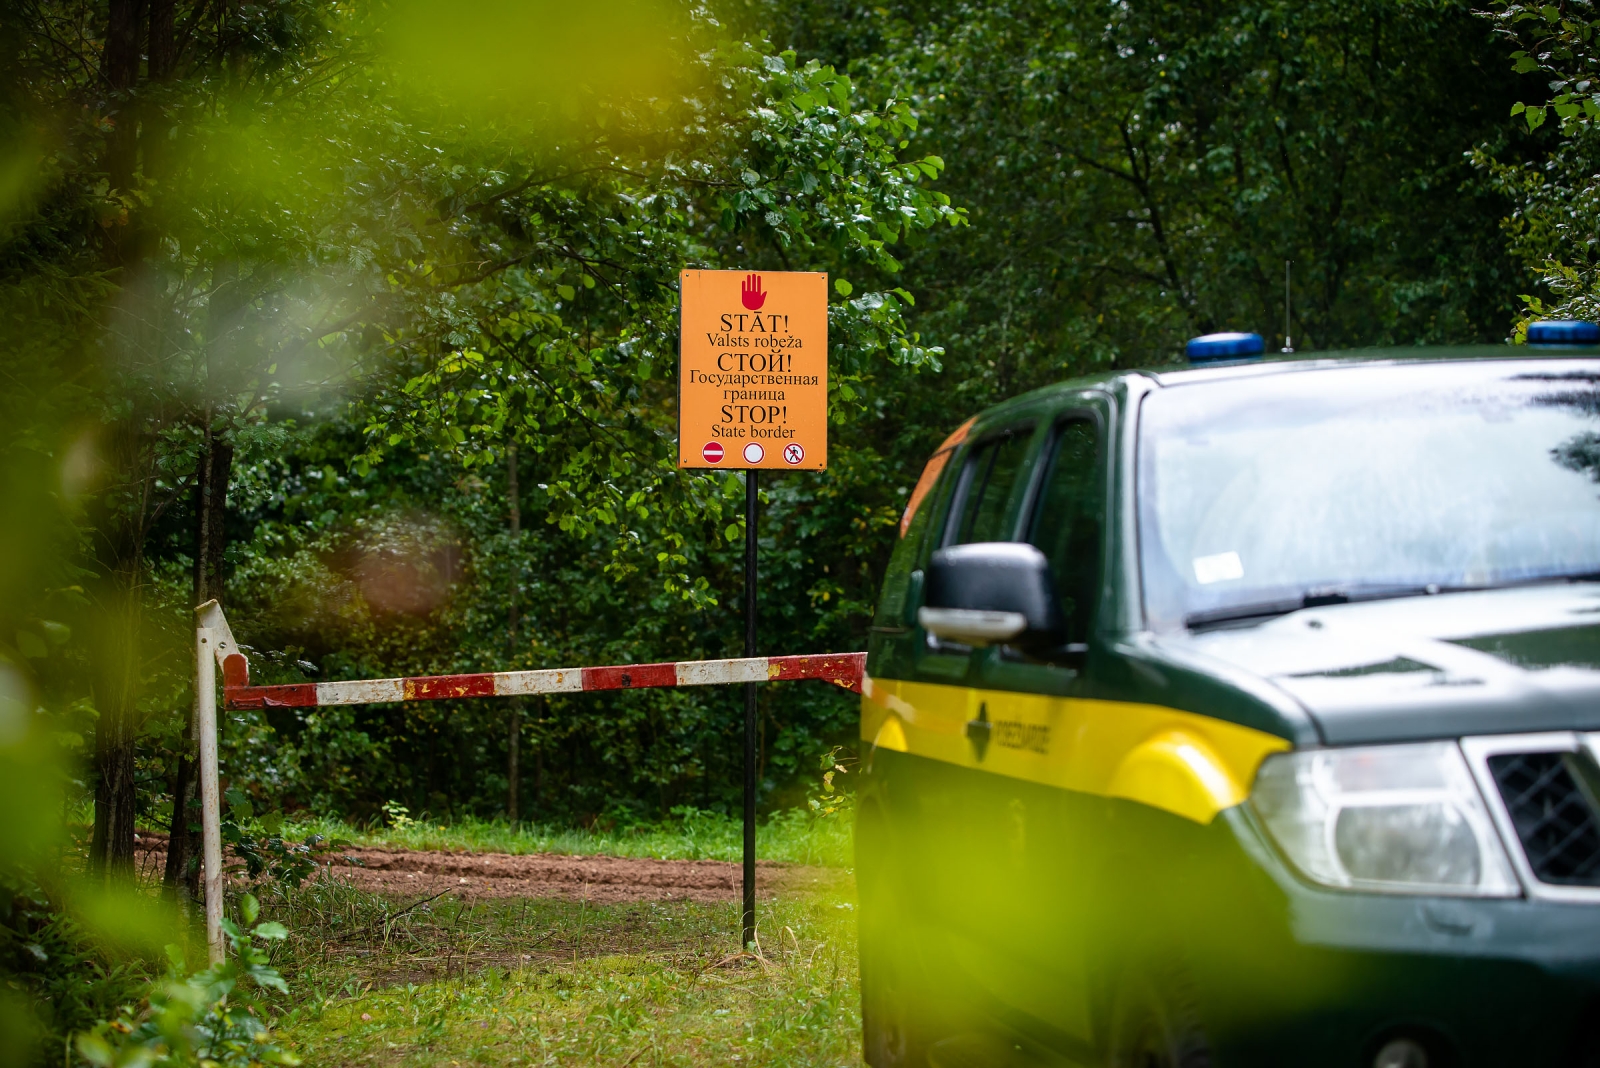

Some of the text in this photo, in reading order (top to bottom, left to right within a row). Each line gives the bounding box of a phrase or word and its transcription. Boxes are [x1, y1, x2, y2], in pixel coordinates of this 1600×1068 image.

[720, 311, 789, 333] STĀT!
[706, 332, 803, 349] Valsts robeža
[717, 349, 791, 373] СТОЙ!
[690, 369, 819, 388] Государственная
[723, 389, 785, 403] граница
[721, 404, 787, 424] STOP!
[711, 424, 796, 439] State border
